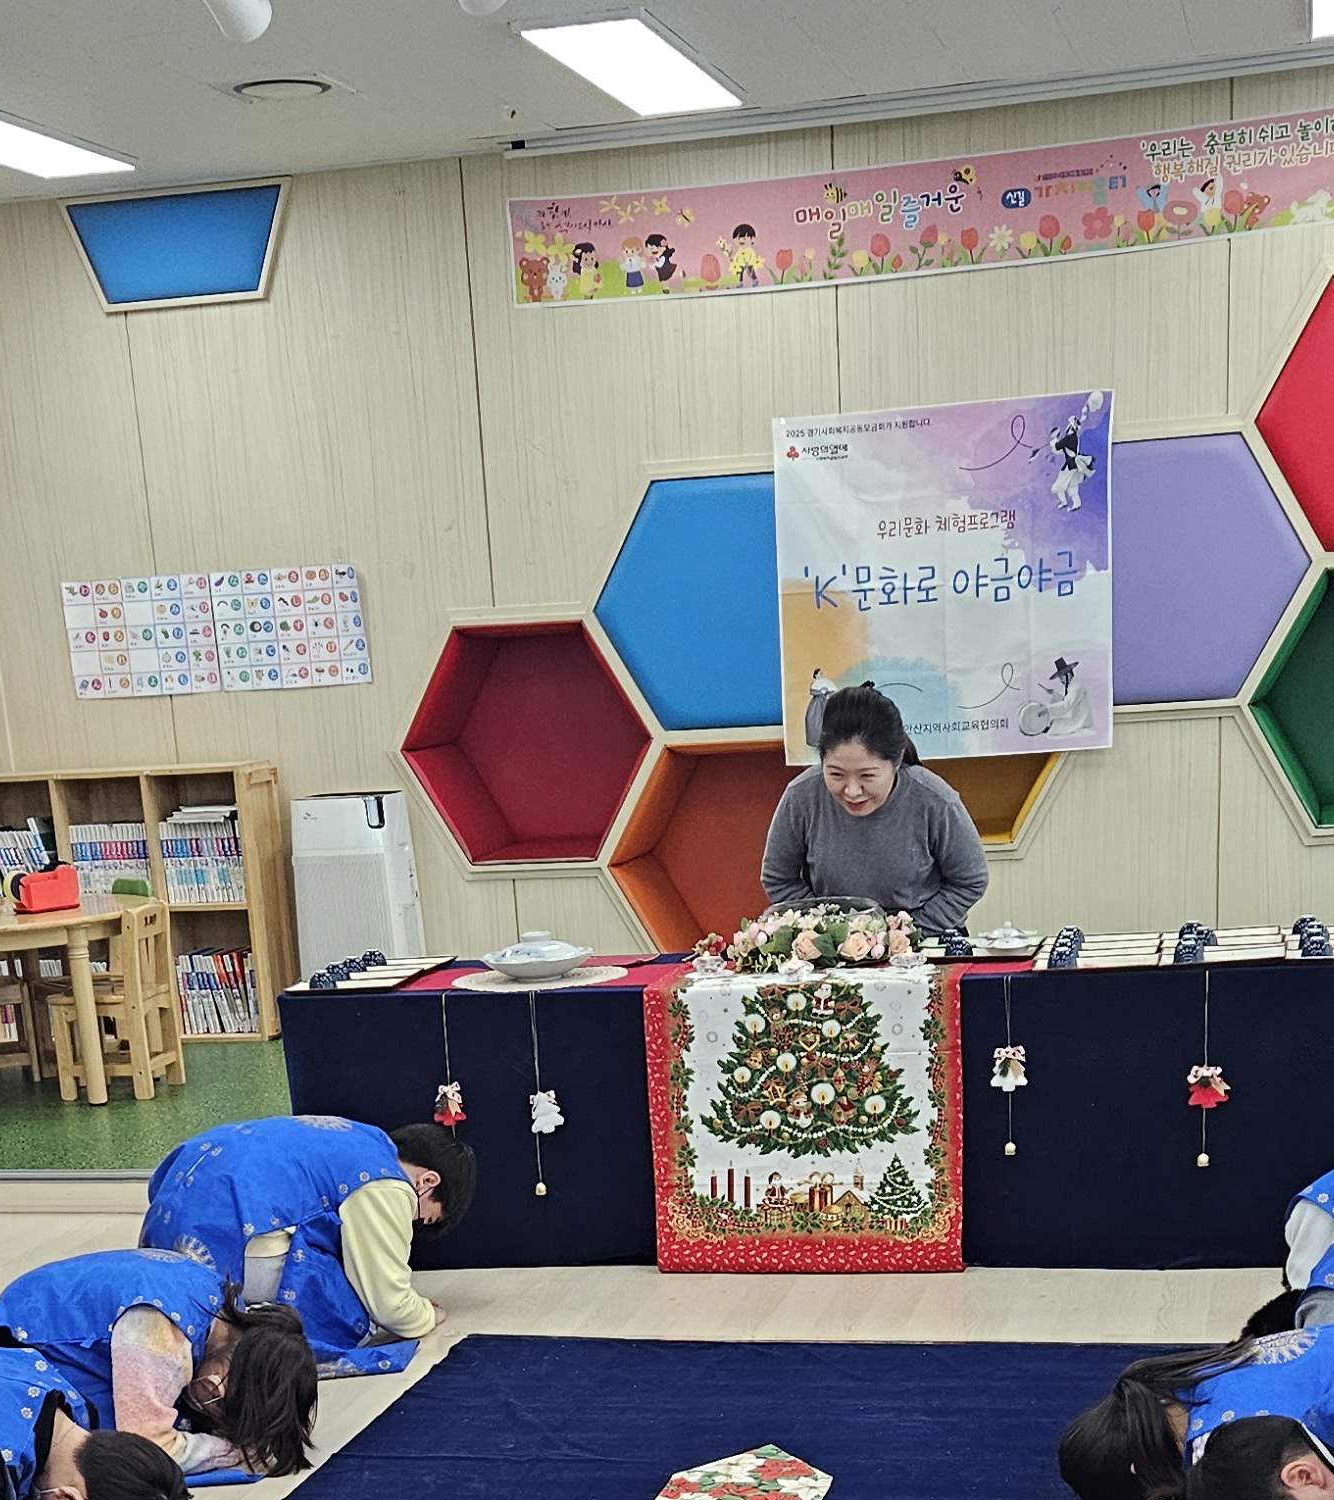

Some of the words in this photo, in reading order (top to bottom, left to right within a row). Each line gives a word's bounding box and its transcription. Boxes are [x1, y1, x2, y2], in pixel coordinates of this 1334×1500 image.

[1203, 128, 1253, 154] 충분히
[1258, 123, 1291, 145] 쉬고
[1152, 155, 1220, 185] 행복해질
[1224, 147, 1276, 173] 권리가
[1004, 188, 1028, 208] 신길
[786, 429, 805, 438] 2025
[877, 516, 930, 540] 우리문화
[936, 509, 1016, 534] 체험프로그램
[953, 551, 1078, 602] 야금야금
